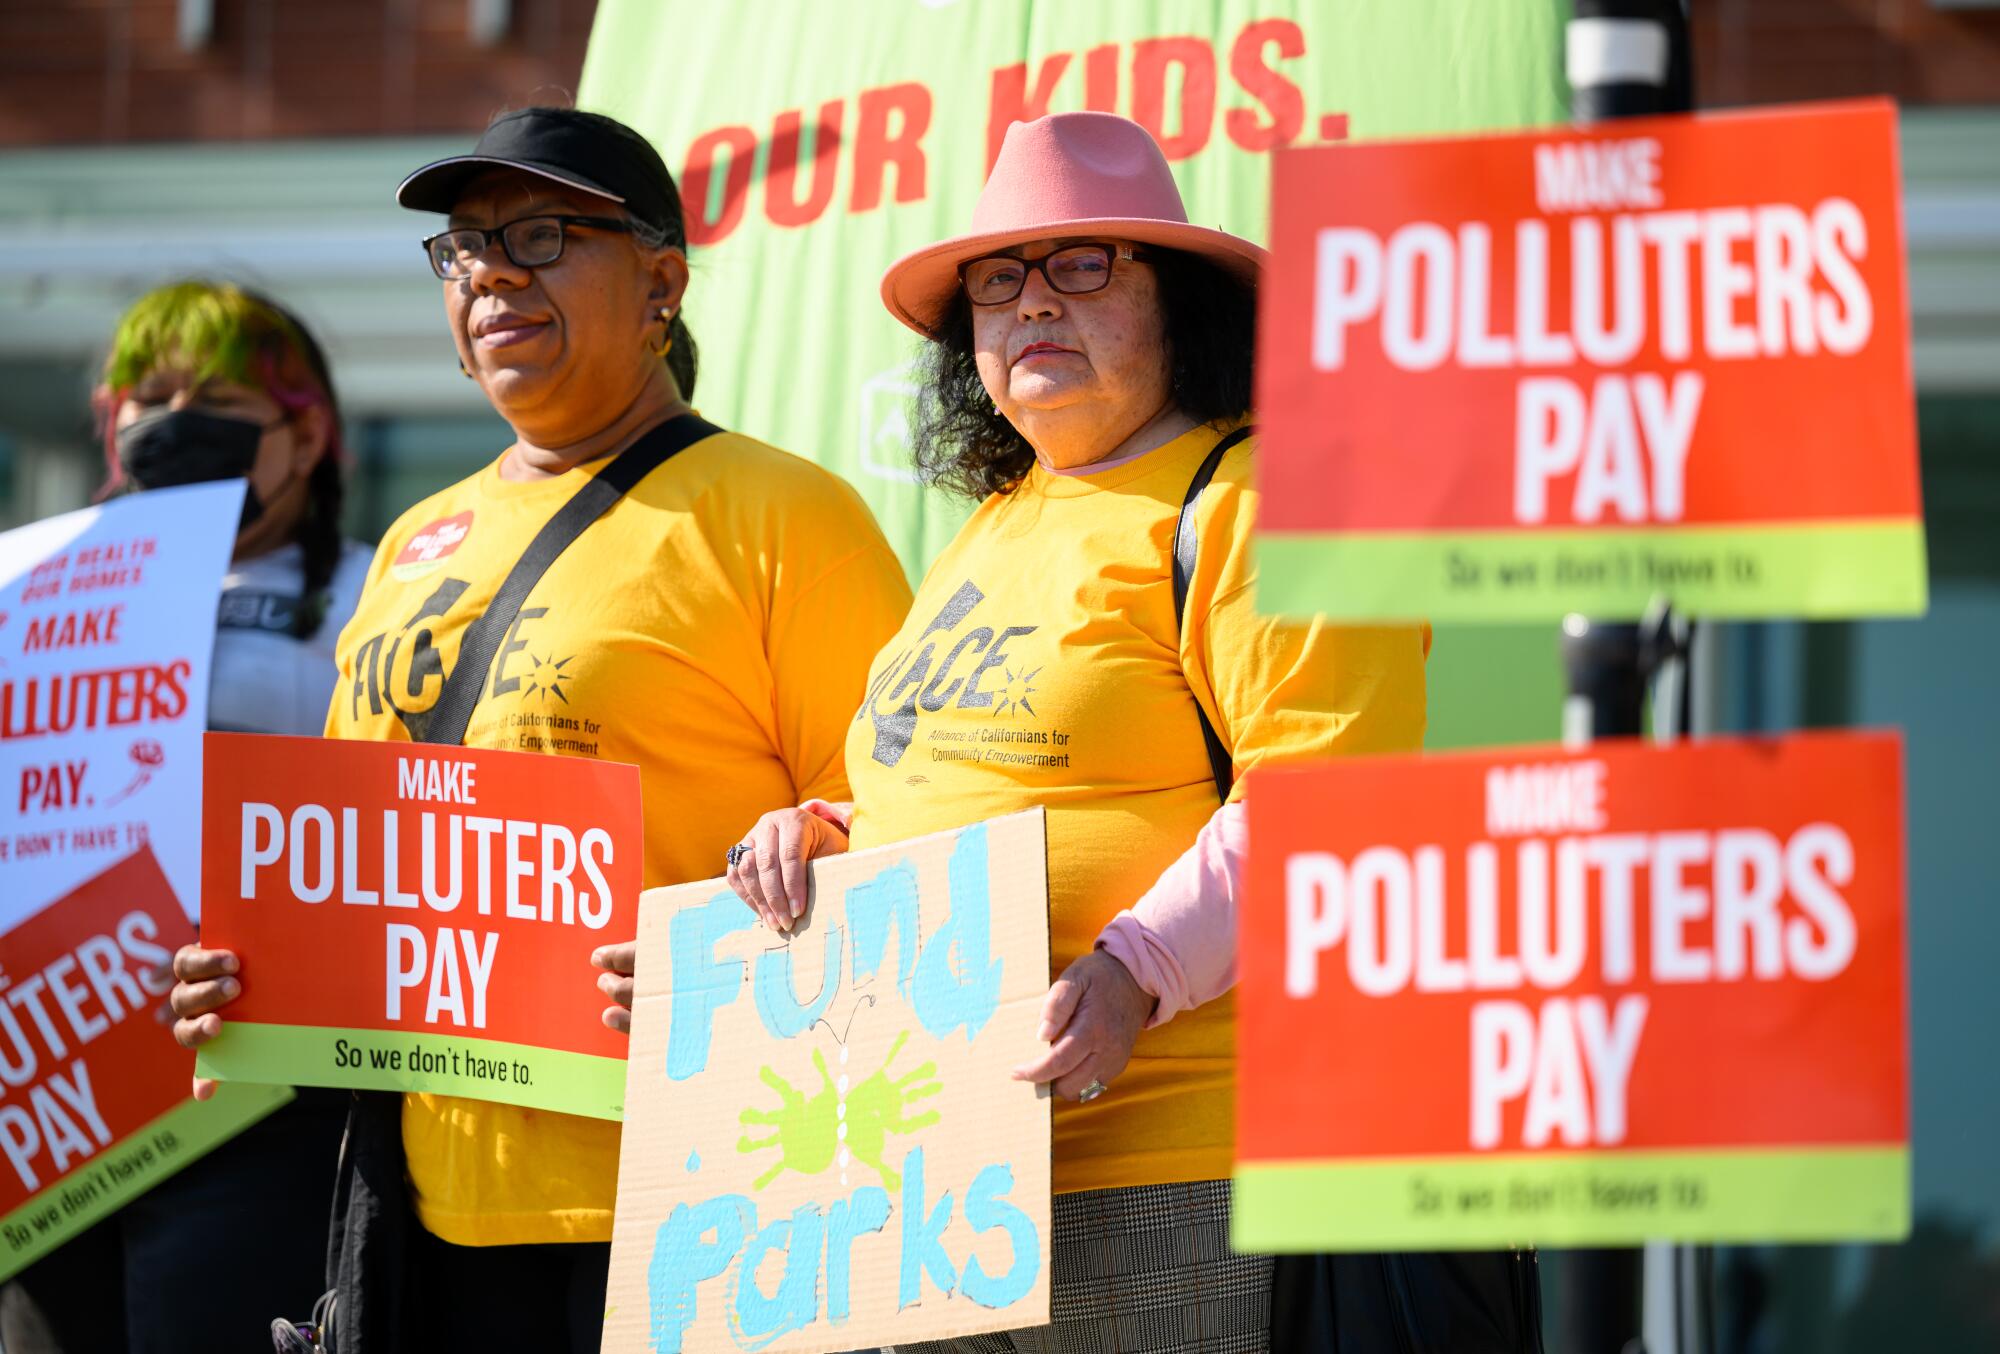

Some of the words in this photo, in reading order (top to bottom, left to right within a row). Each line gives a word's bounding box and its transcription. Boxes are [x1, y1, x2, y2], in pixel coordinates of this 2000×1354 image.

[681, 80, 933, 248] OUR
[984, 19, 1348, 182] KIDS.
[1534, 139, 1664, 211] MAKE
[1311, 197, 1873, 371] POLLUTERS
[1512, 370, 1705, 524] PAY
[23, 602, 125, 655] MAKE
[353, 608, 550, 721] ACE
[511, 711, 579, 731] Californians
[584, 719, 601, 735] for
[519, 734, 599, 756] Empowerment
[928, 730, 964, 741] Alliance
[968, 729, 979, 741] of
[981, 728, 1048, 744] Californians
[1052, 730, 1070, 746] for
[932, 748, 984, 764] Community
[985, 749, 1070, 768] Empowerment
[19, 759, 94, 815] PAY.
[398, 757, 476, 804] MAKE
[1484, 761, 1608, 835] MAKE
[241, 802, 614, 929] POLLUTERS
[1284, 822, 1858, 998] POLLUTERS
[0, 910, 175, 1087] UTERS
[386, 922, 499, 1029] PAY
[666, 822, 1003, 1081] Fund
[335, 1039, 362, 1068] So
[369, 1048, 402, 1071] we
[409, 1045, 461, 1076] don't
[466, 1050, 507, 1082] have
[513, 1060, 533, 1086] to.
[1467, 994, 1650, 1150] PAY
[0, 1058, 113, 1192] PAY
[2, 1222, 33, 1252] So
[30, 1204, 62, 1235] we
[60, 1171, 110, 1217] don't
[104, 1144, 156, 1187] have
